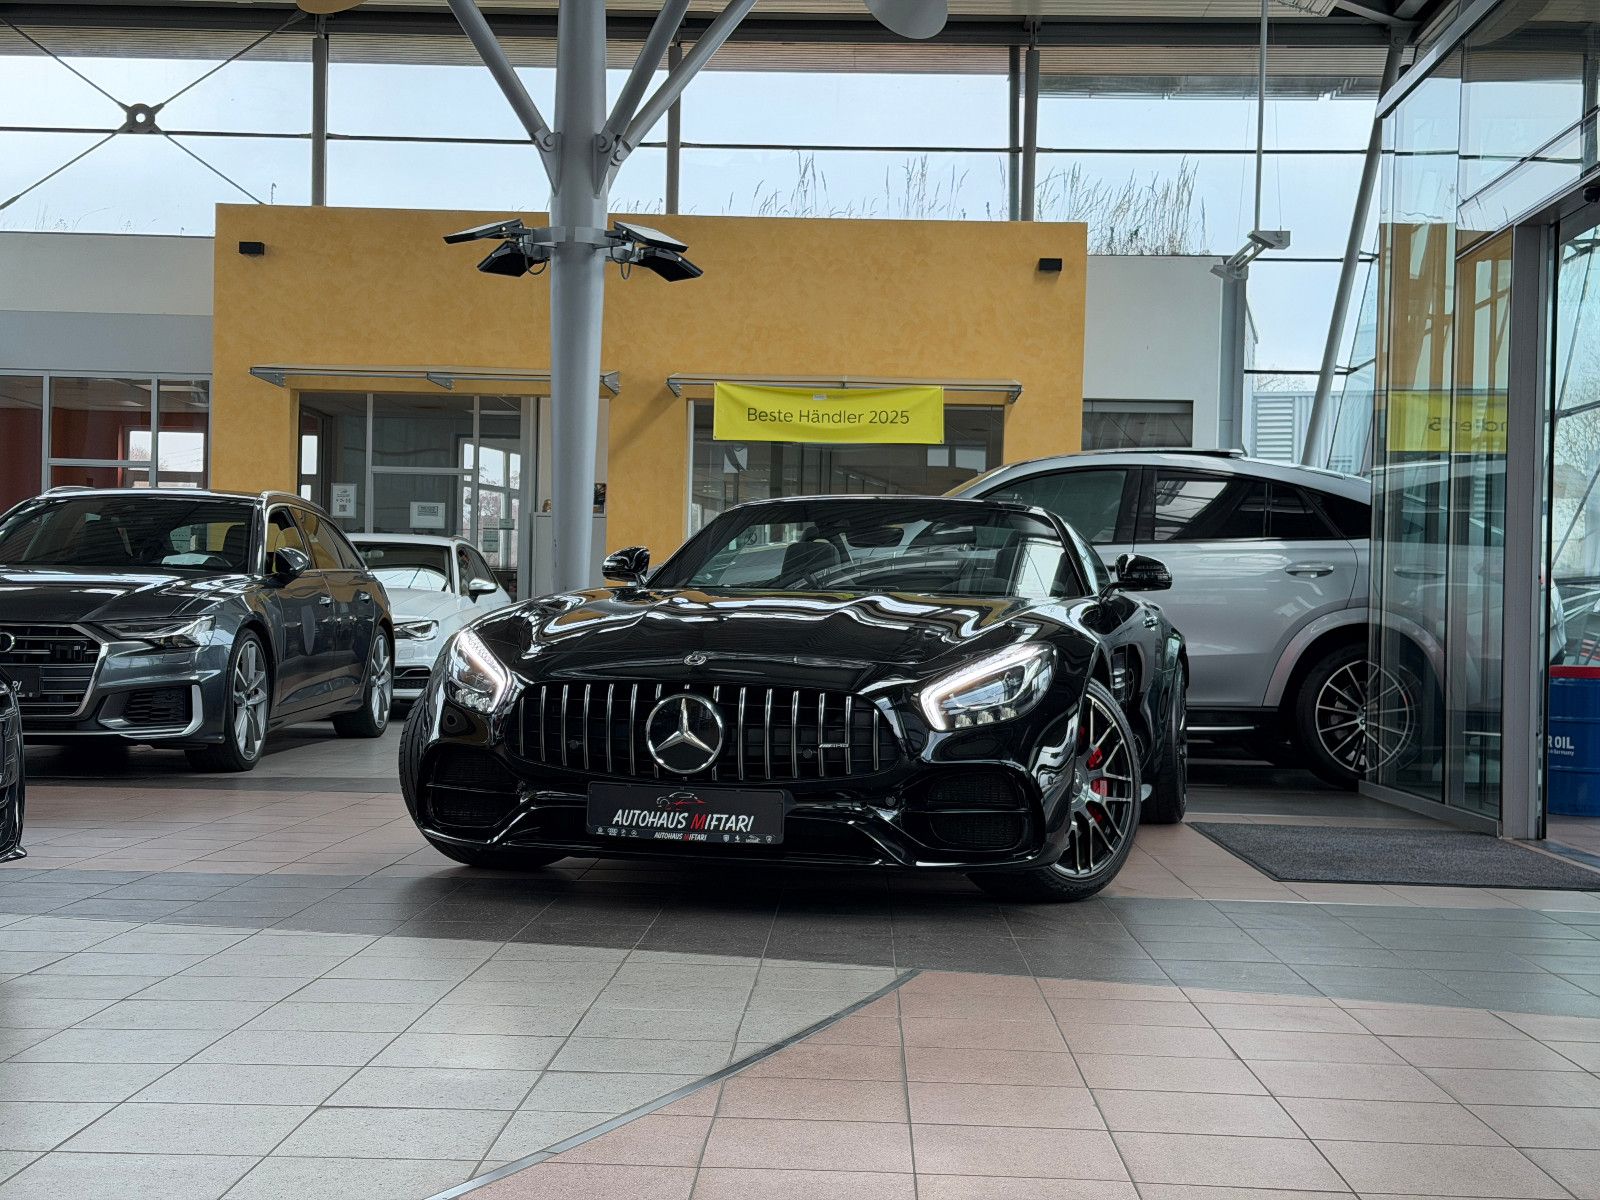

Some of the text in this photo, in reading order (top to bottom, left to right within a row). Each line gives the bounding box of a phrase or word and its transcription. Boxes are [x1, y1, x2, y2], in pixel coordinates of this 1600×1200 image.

[747, 407, 910, 425] Beste Händler 2025
[1554, 736, 1575, 749] OIL
[612, 808, 755, 832] AUTOHAUS MIFTARI
[654, 832, 707, 842] AUTOHAUS MIFTARI
